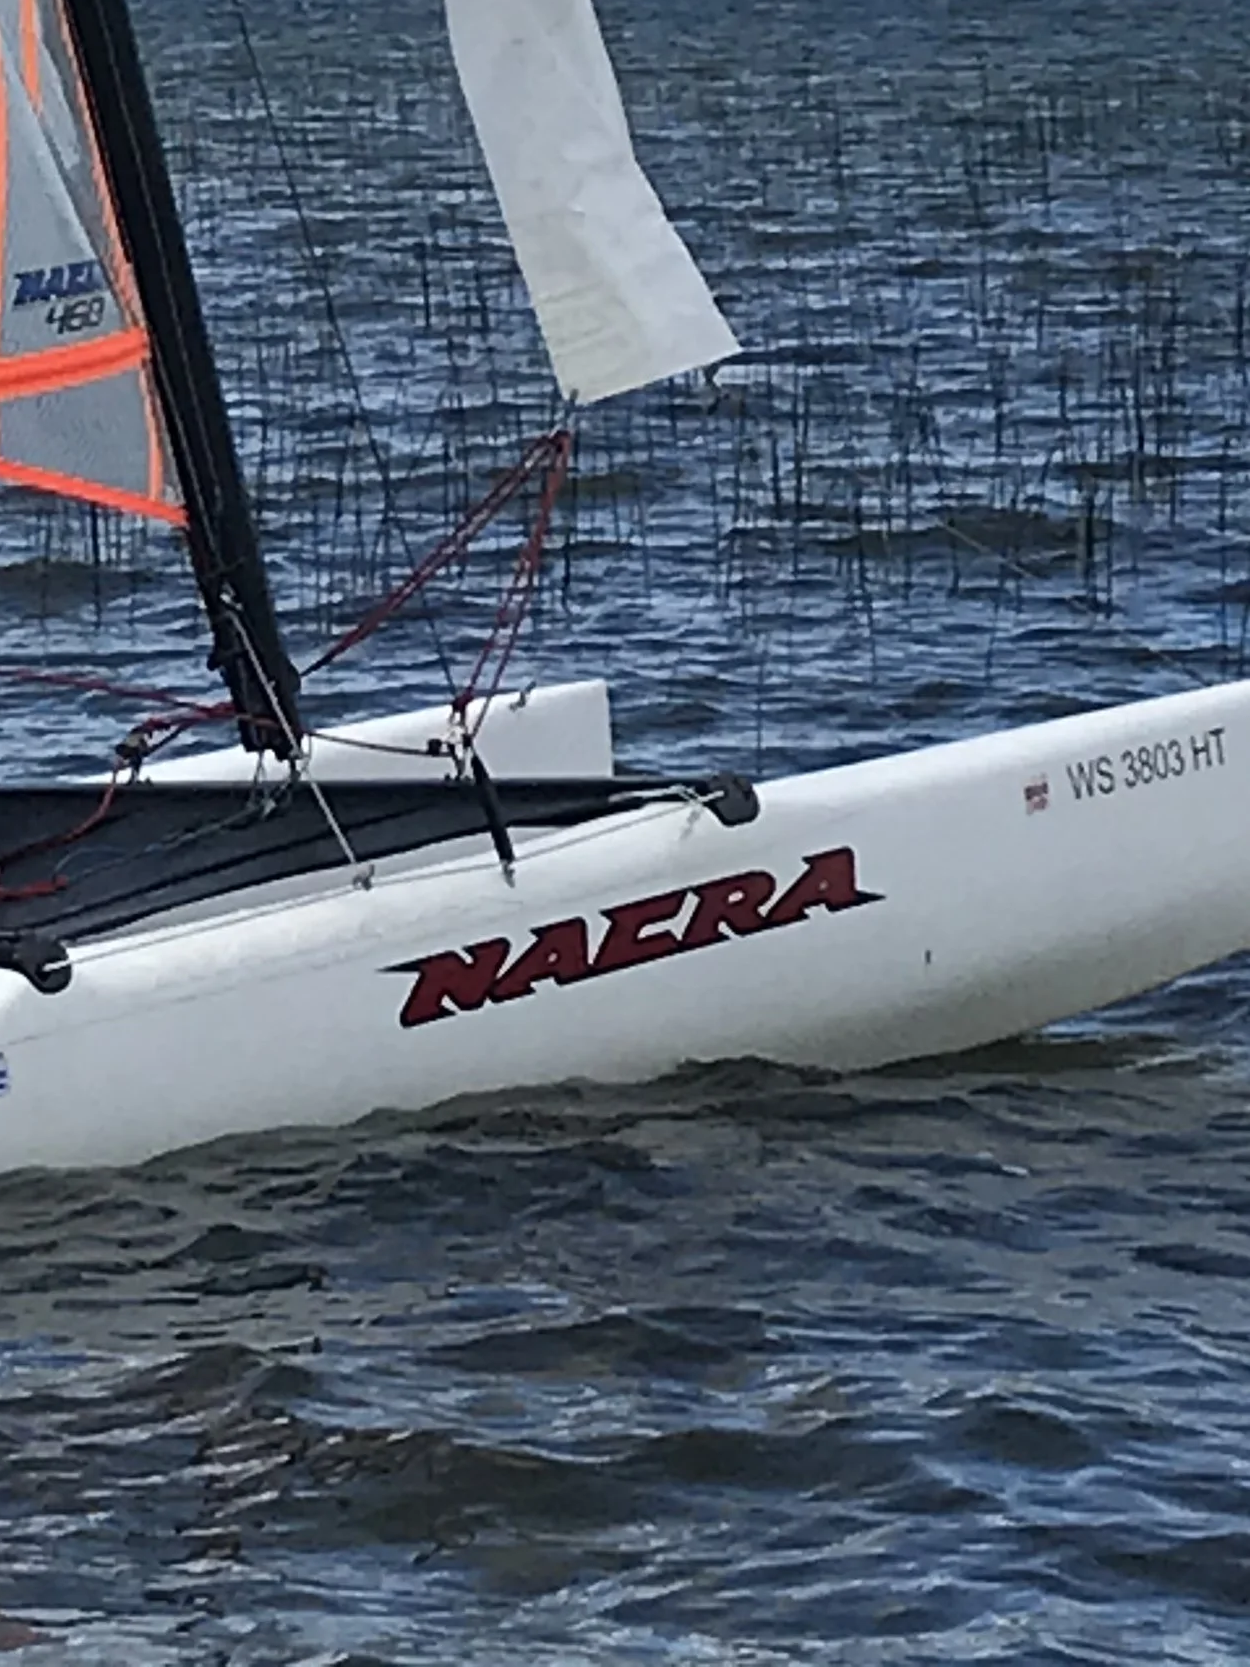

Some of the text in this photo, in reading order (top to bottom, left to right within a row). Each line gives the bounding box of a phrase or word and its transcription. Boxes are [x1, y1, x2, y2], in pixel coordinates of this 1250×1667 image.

[1066, 727, 1226, 799] WS 3803 HT
[376, 845, 887, 1028] NACRA
